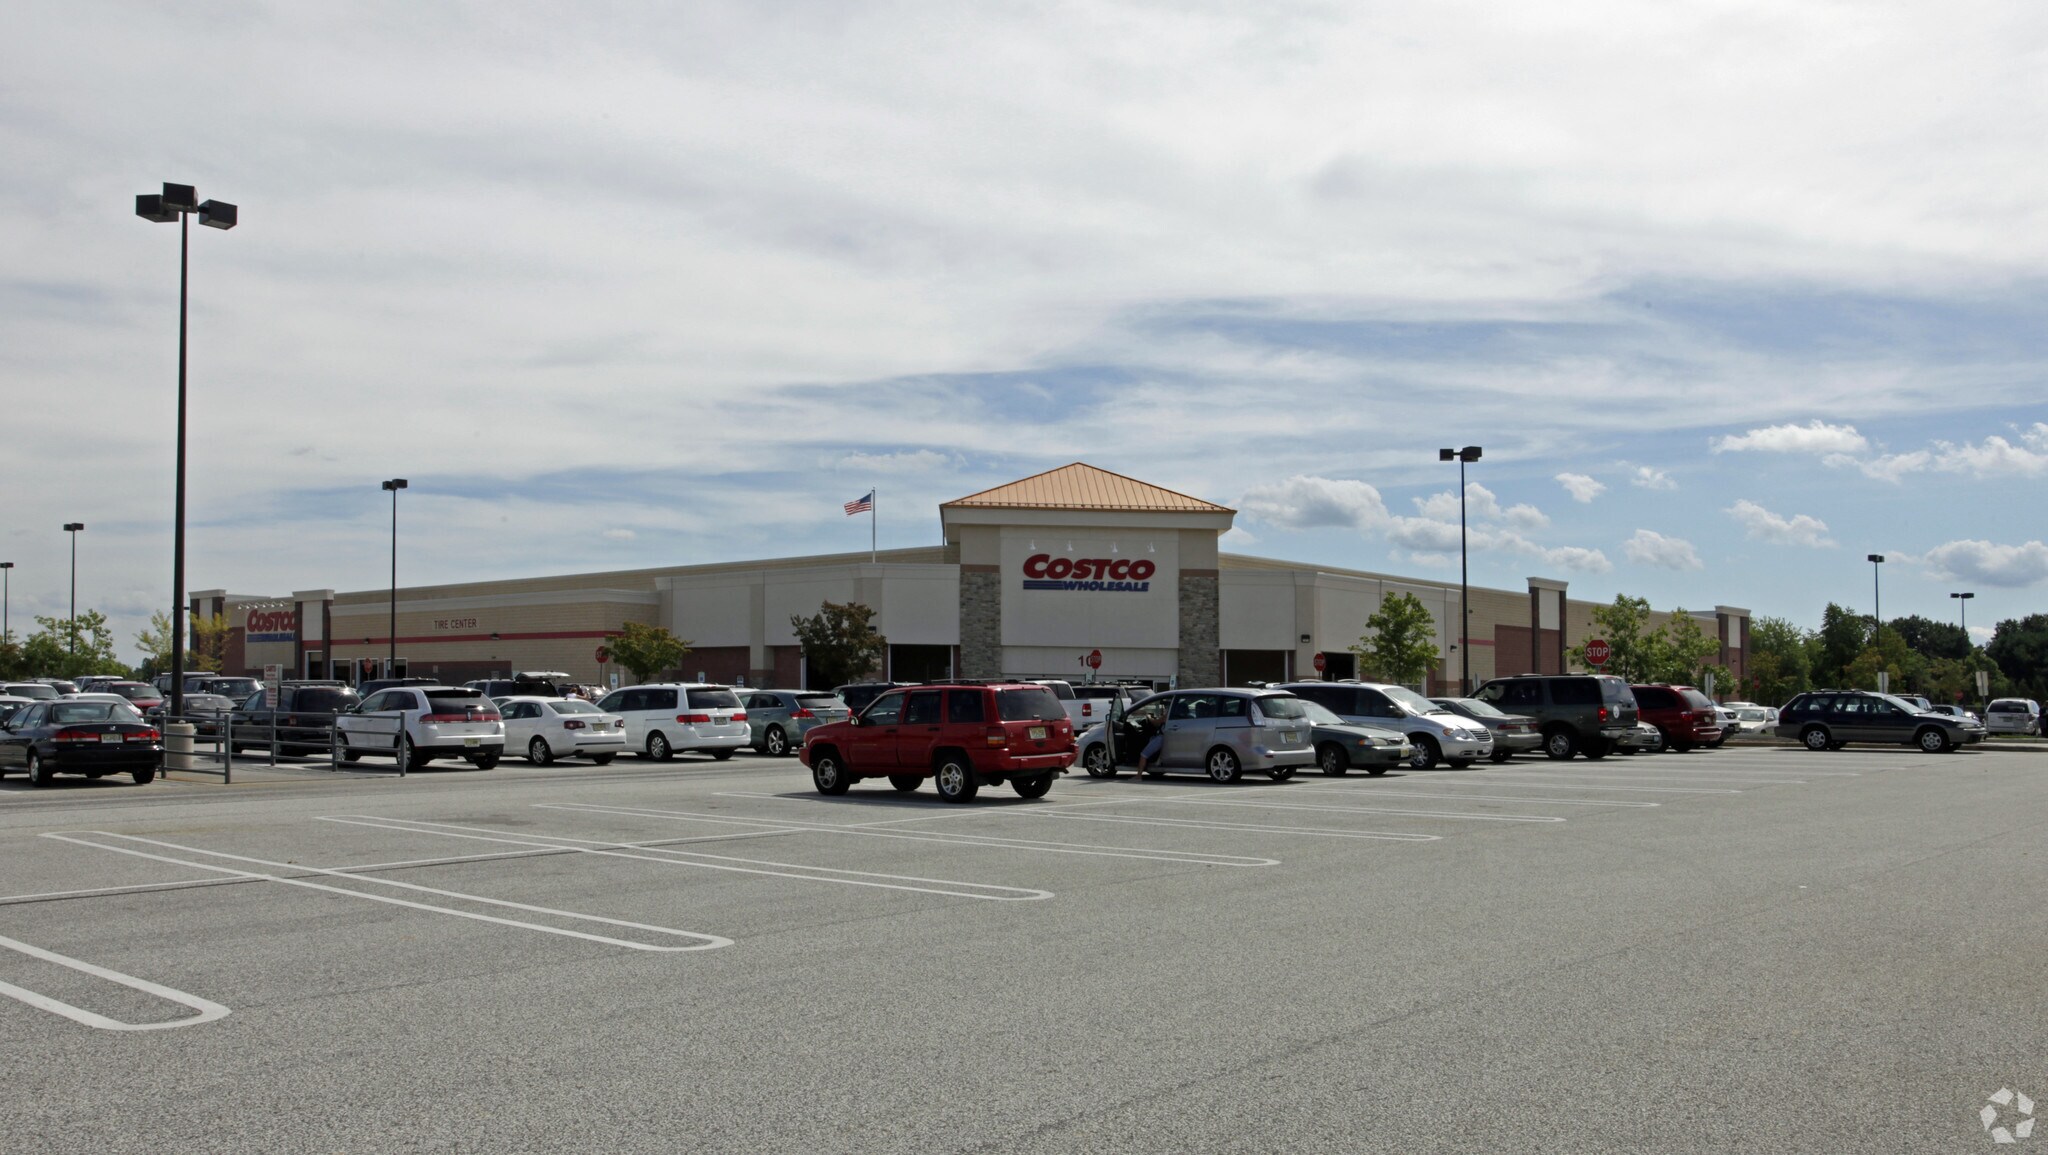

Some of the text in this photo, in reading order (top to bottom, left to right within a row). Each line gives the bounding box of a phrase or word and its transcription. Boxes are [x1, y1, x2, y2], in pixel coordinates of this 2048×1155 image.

[1023, 554, 1156, 580] COSTCO
[1062, 581, 1150, 592] WHOLESALE
[434, 618, 477, 630] TIRE CENTER
[1586, 647, 1609, 657] STOP
